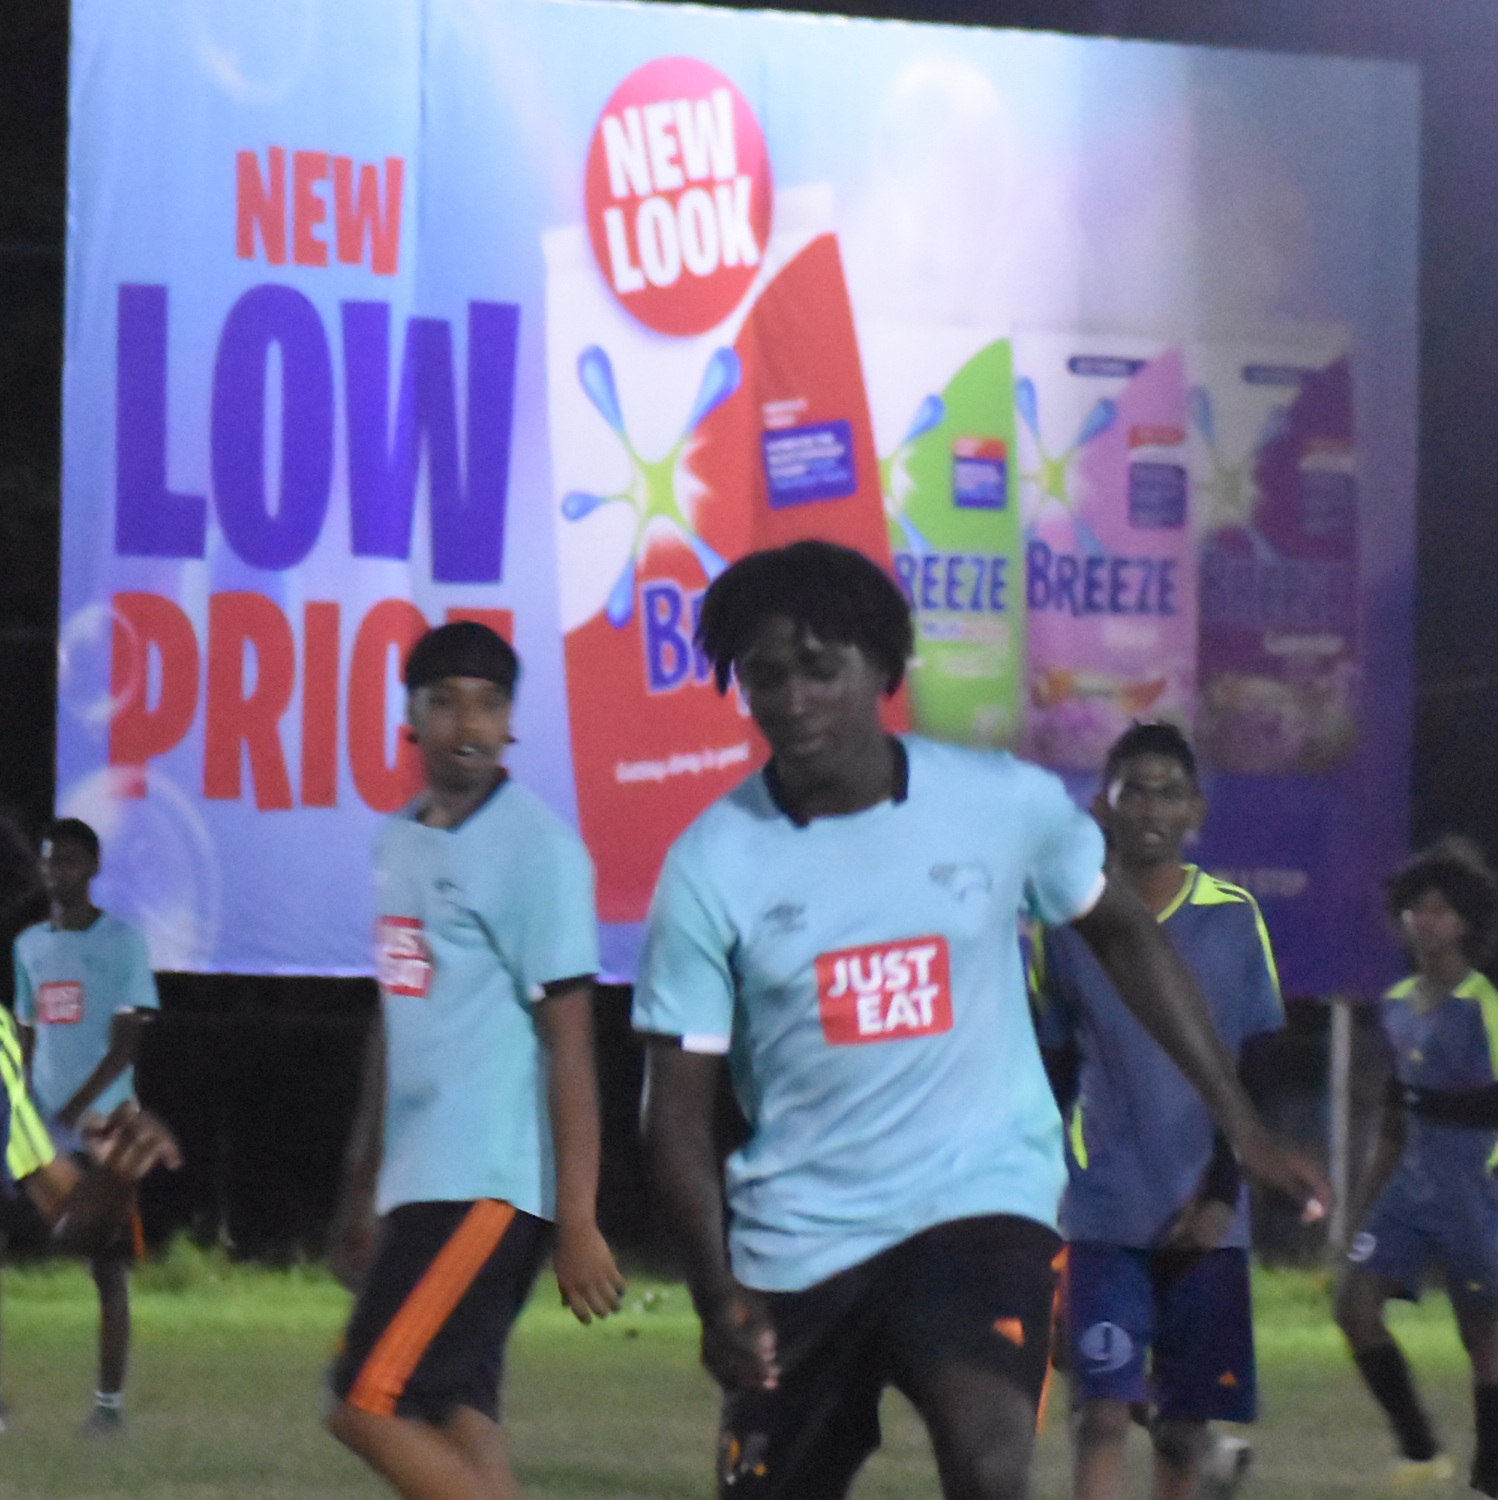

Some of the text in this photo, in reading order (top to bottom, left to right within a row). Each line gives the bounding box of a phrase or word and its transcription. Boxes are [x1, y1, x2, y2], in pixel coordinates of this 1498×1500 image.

[603, 88, 737, 198] NEW
[235, 145, 405, 276] NEW
[605, 175, 760, 294] LOOK
[115, 284, 521, 585] LOW
[894, 553, 1007, 611] REEZE
[1027, 540, 1176, 616] BREEZE
[109, 591, 515, 813] PRIC
[827, 944, 938, 998] JUST
[856, 984, 940, 1035] EAT
